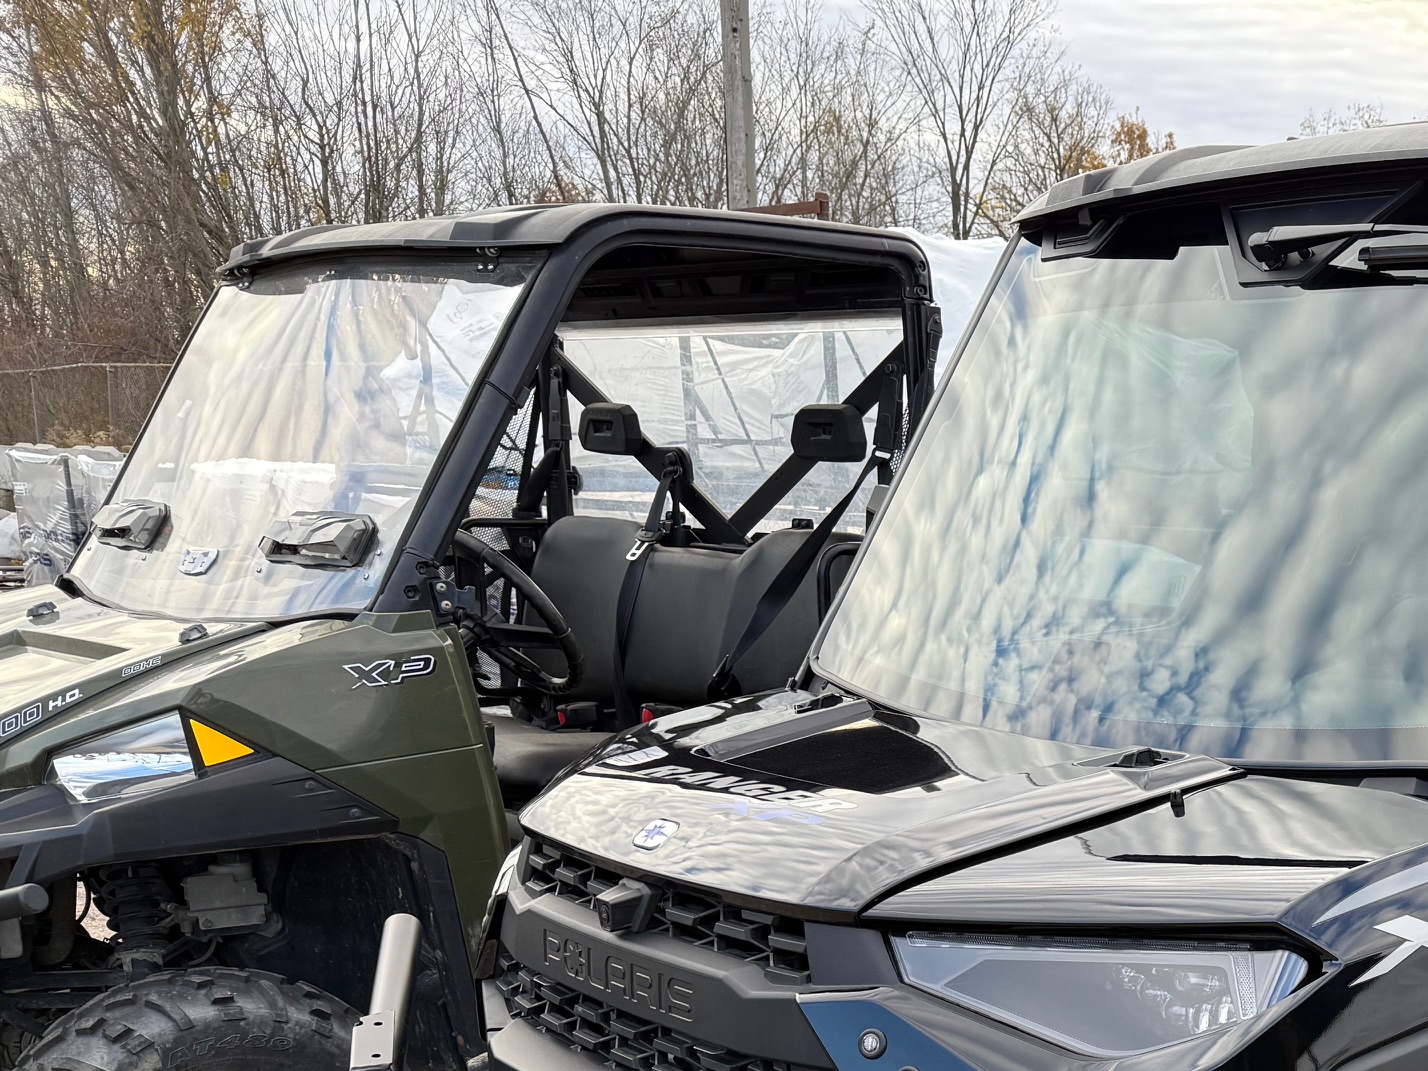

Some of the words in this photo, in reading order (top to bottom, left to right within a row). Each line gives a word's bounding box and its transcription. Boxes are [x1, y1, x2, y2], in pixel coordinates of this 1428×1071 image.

[342, 654, 437, 690] XP
[639, 764, 859, 813] RANGER
[542, 927, 695, 1023] POLARIS
